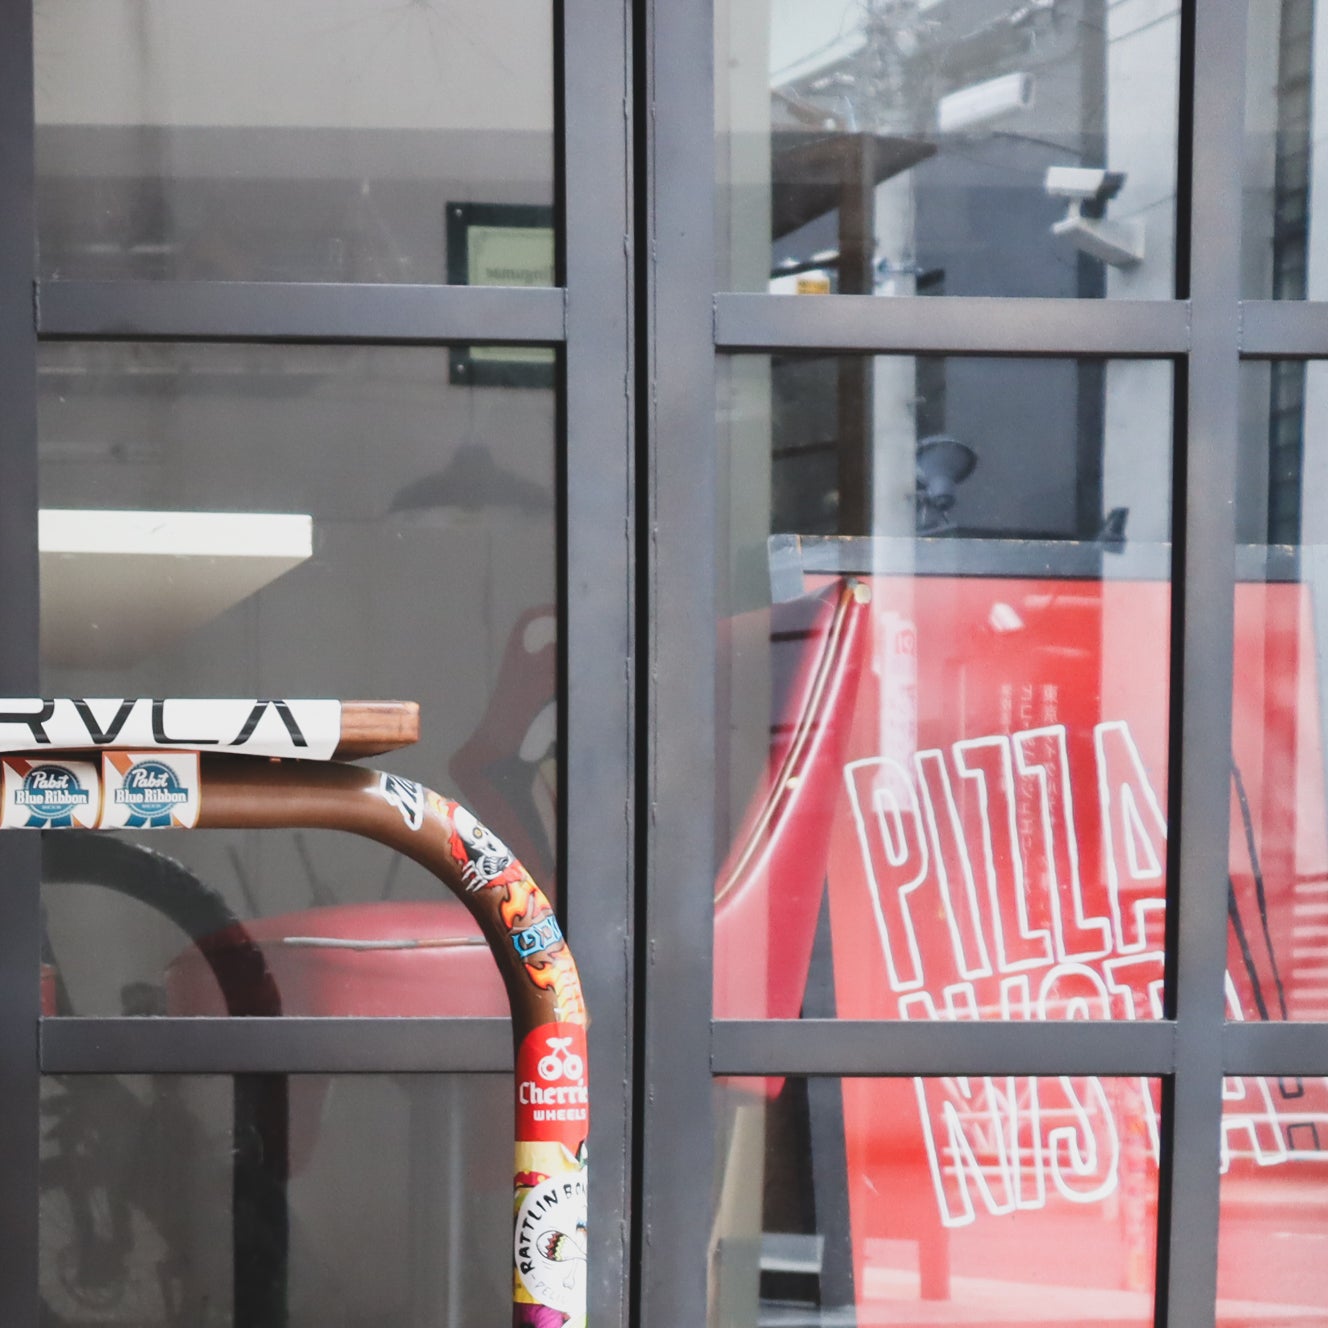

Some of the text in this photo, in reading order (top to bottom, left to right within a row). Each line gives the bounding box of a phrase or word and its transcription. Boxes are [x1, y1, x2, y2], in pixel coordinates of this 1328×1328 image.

[31, 771, 70, 789] Pabst
[131, 768, 169, 788] Pabst
[15, 789, 88, 805] Blue Ribbon
[115, 788, 188, 803] Blue Ribbon
